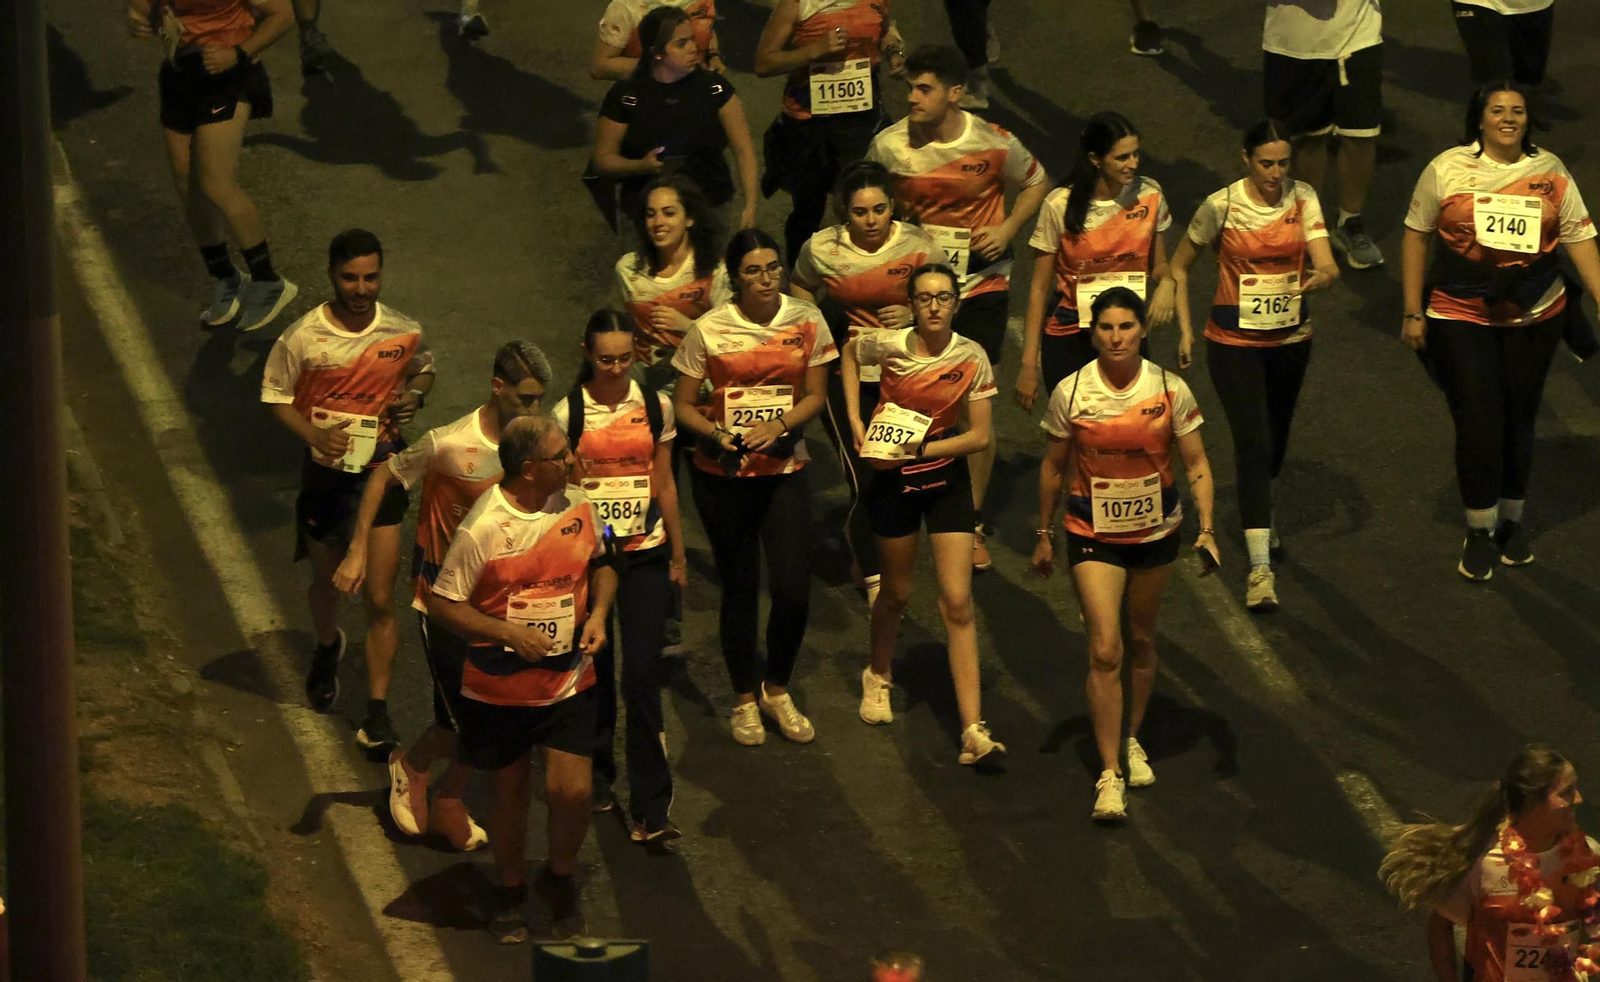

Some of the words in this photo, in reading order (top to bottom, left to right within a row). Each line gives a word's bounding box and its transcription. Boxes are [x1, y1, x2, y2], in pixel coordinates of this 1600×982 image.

[818, 80, 865, 100] 11503
[1486, 215, 1527, 236] 2140
[1252, 296, 1290, 315] 2162
[732, 408, 785, 427] 22578
[868, 425, 915, 445] 23837
[1101, 497, 1154, 519] 10723
[521, 574, 573, 589] NOCTURNA
